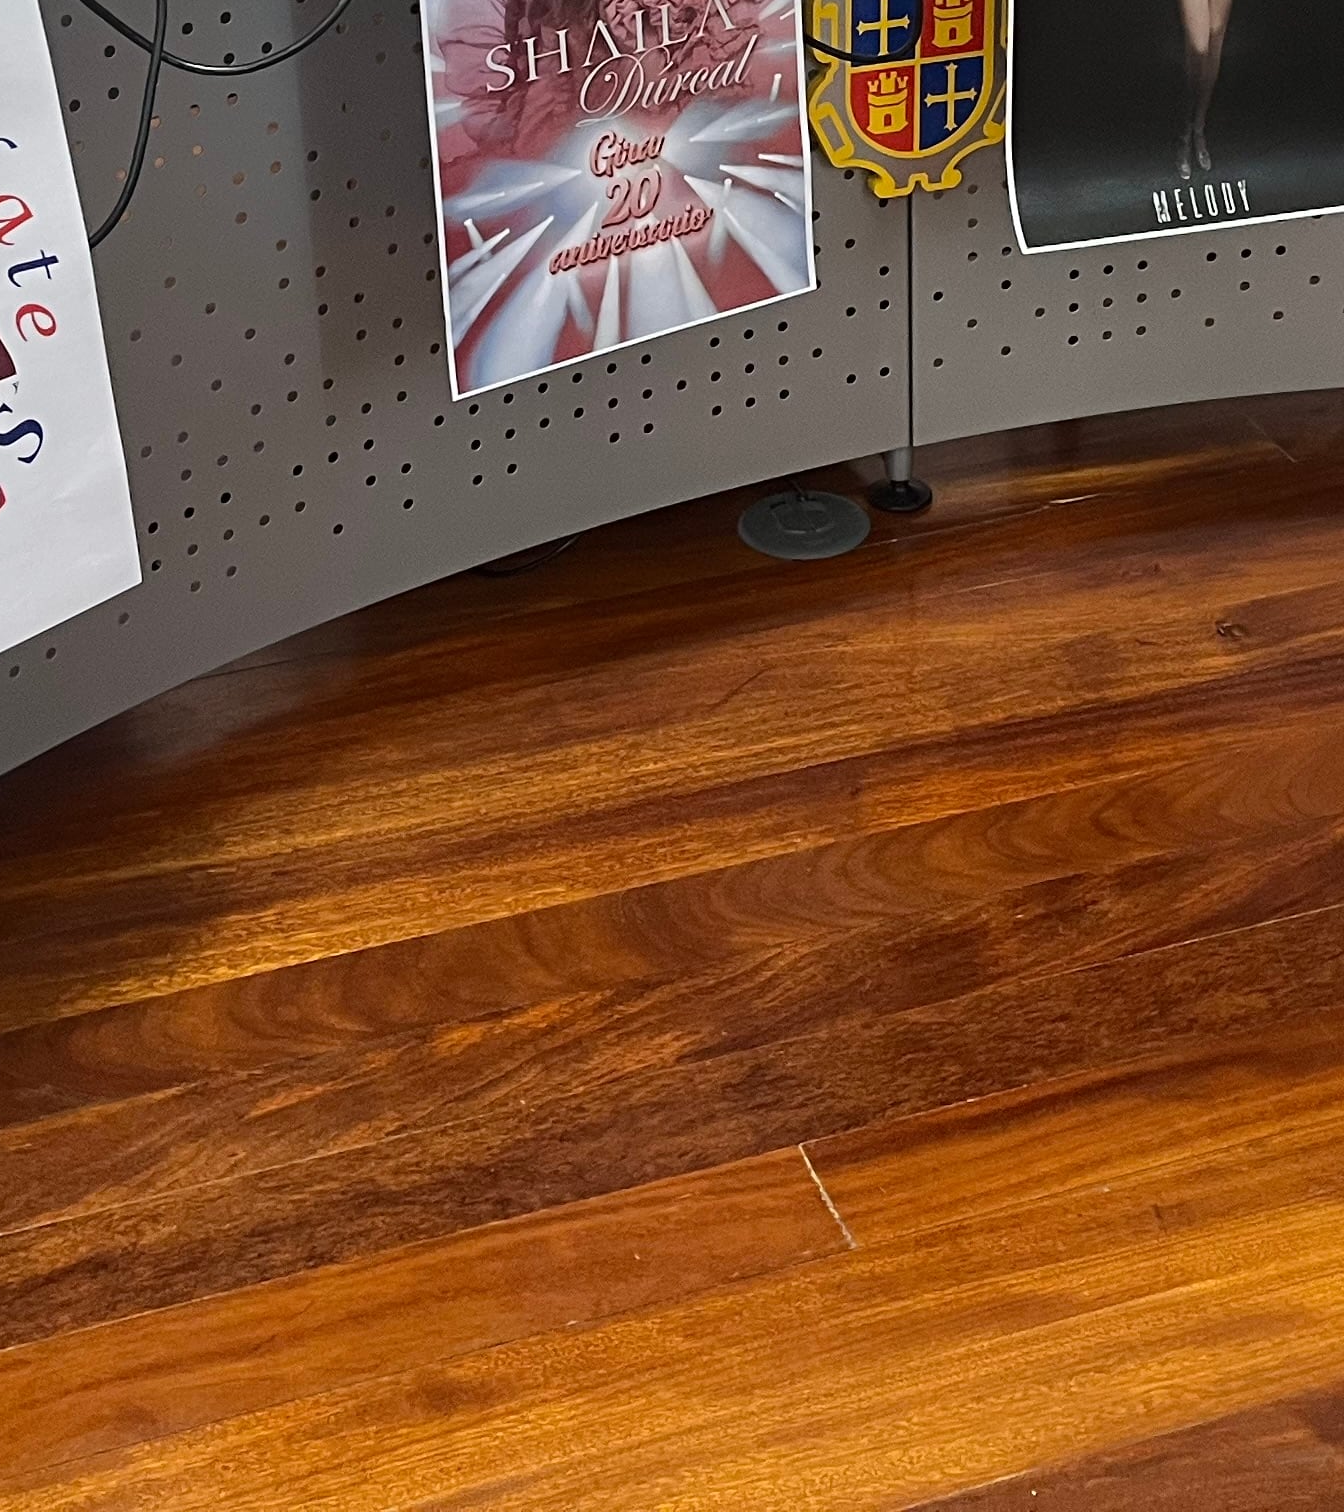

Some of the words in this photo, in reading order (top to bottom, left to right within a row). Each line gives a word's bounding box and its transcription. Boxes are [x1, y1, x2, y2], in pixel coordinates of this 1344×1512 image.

[576, 34, 758, 127] Dúrcal
[590, 131, 665, 176] Gira
[602, 164, 661, 229] 20
[1153, 179, 1249, 223] MELODY
[549, 203, 715, 274] aniversario
